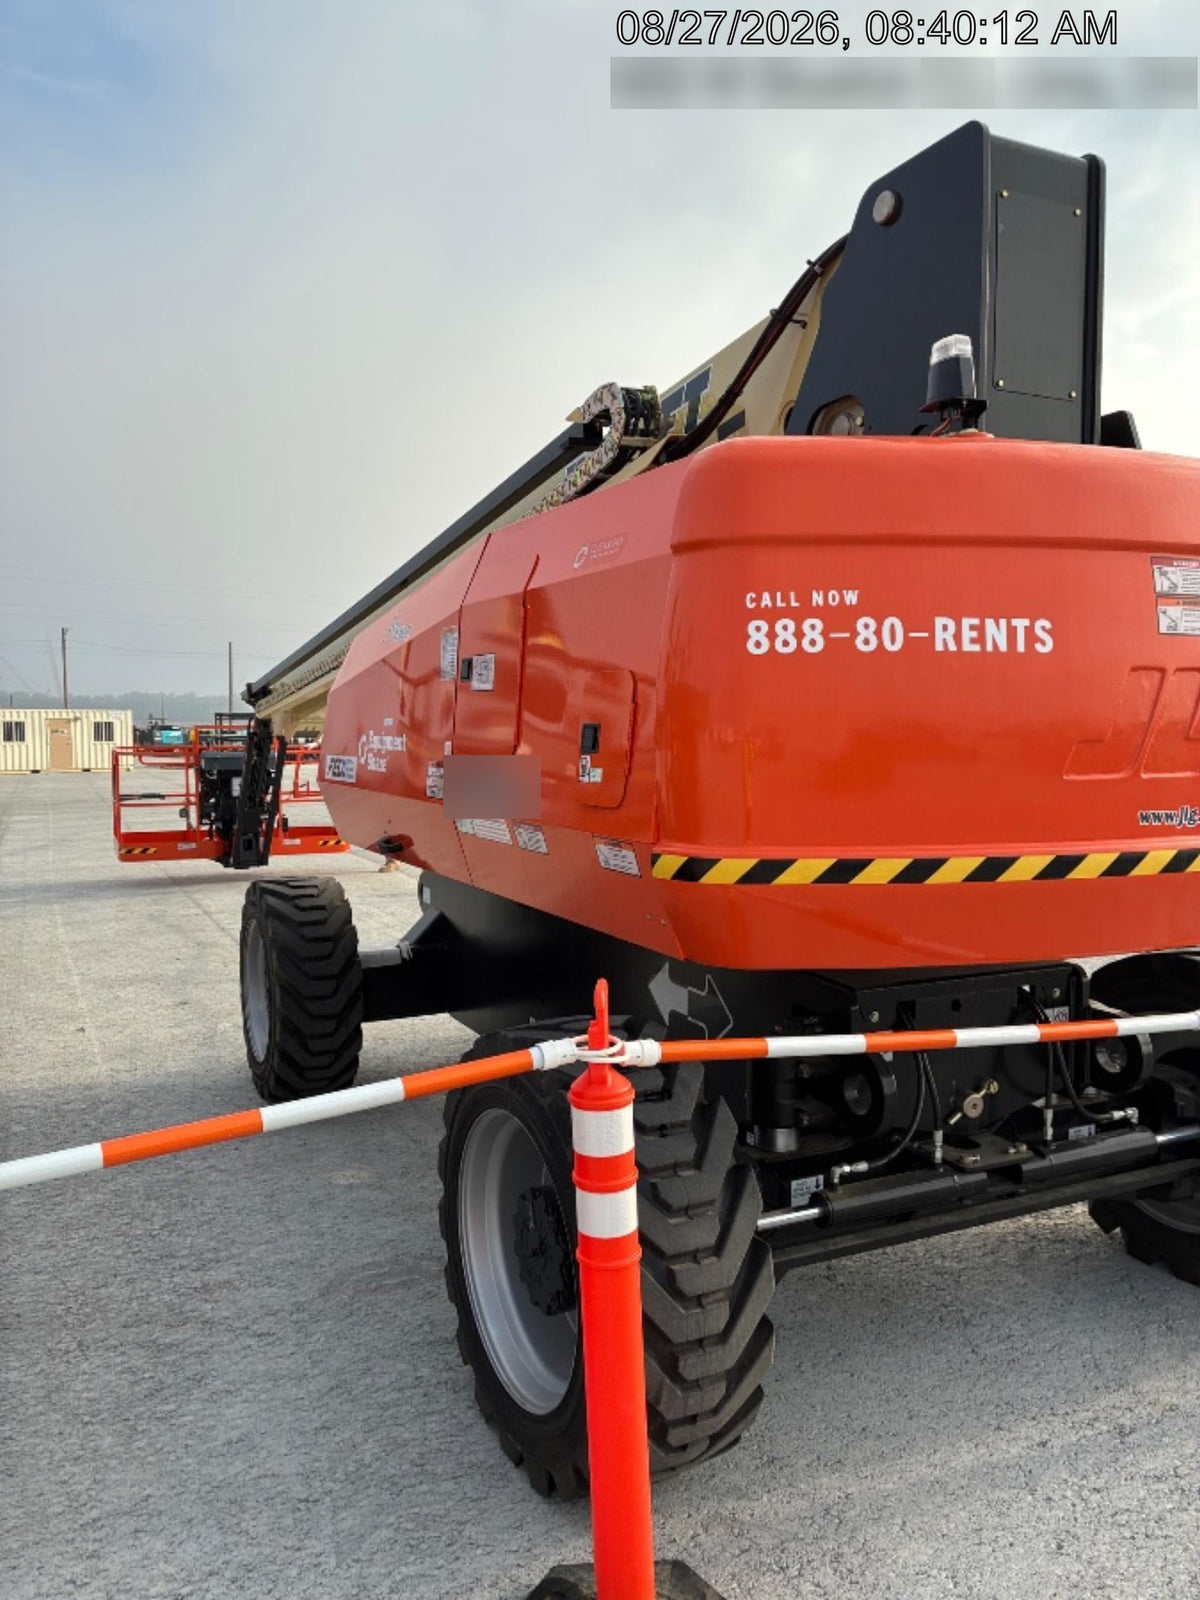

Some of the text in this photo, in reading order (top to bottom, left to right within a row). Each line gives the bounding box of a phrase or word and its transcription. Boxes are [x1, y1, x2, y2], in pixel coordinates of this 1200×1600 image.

[745, 589, 859, 609] CALL NOW
[746, 616, 1054, 655] 888-80-RENTS
